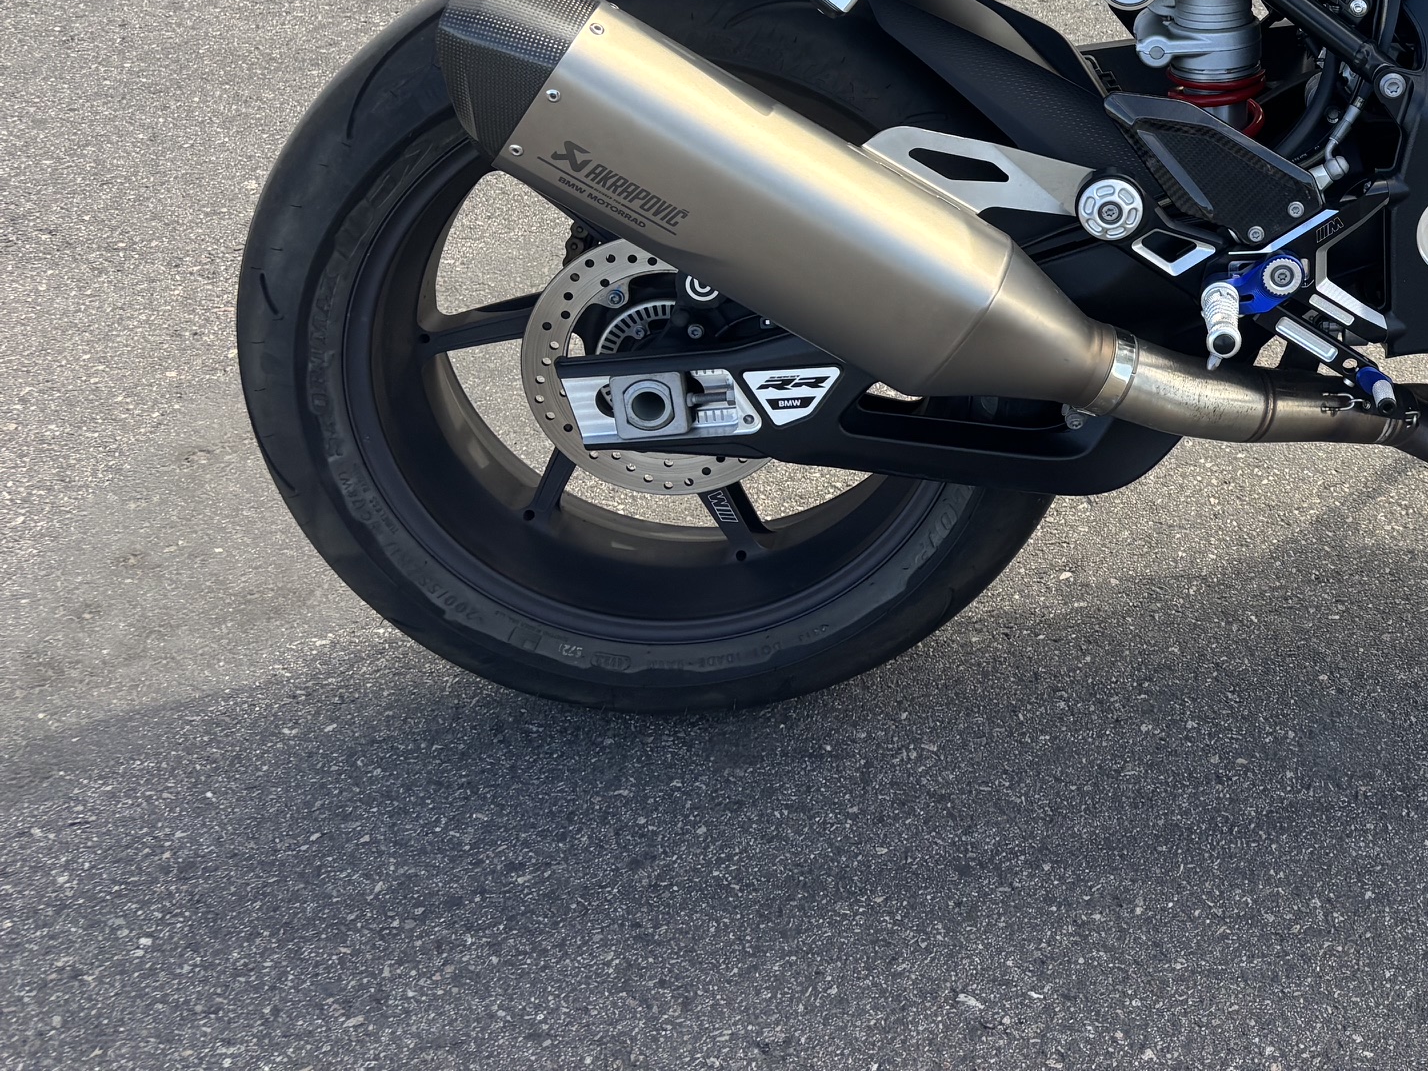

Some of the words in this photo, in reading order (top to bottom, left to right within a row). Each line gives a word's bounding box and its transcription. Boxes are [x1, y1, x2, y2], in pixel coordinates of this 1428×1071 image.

[558, 176, 586, 195] BMW
[587, 191, 646, 228] MOTORRAD
[756, 376, 831, 391] RR
[778, 399, 801, 407] BMW
